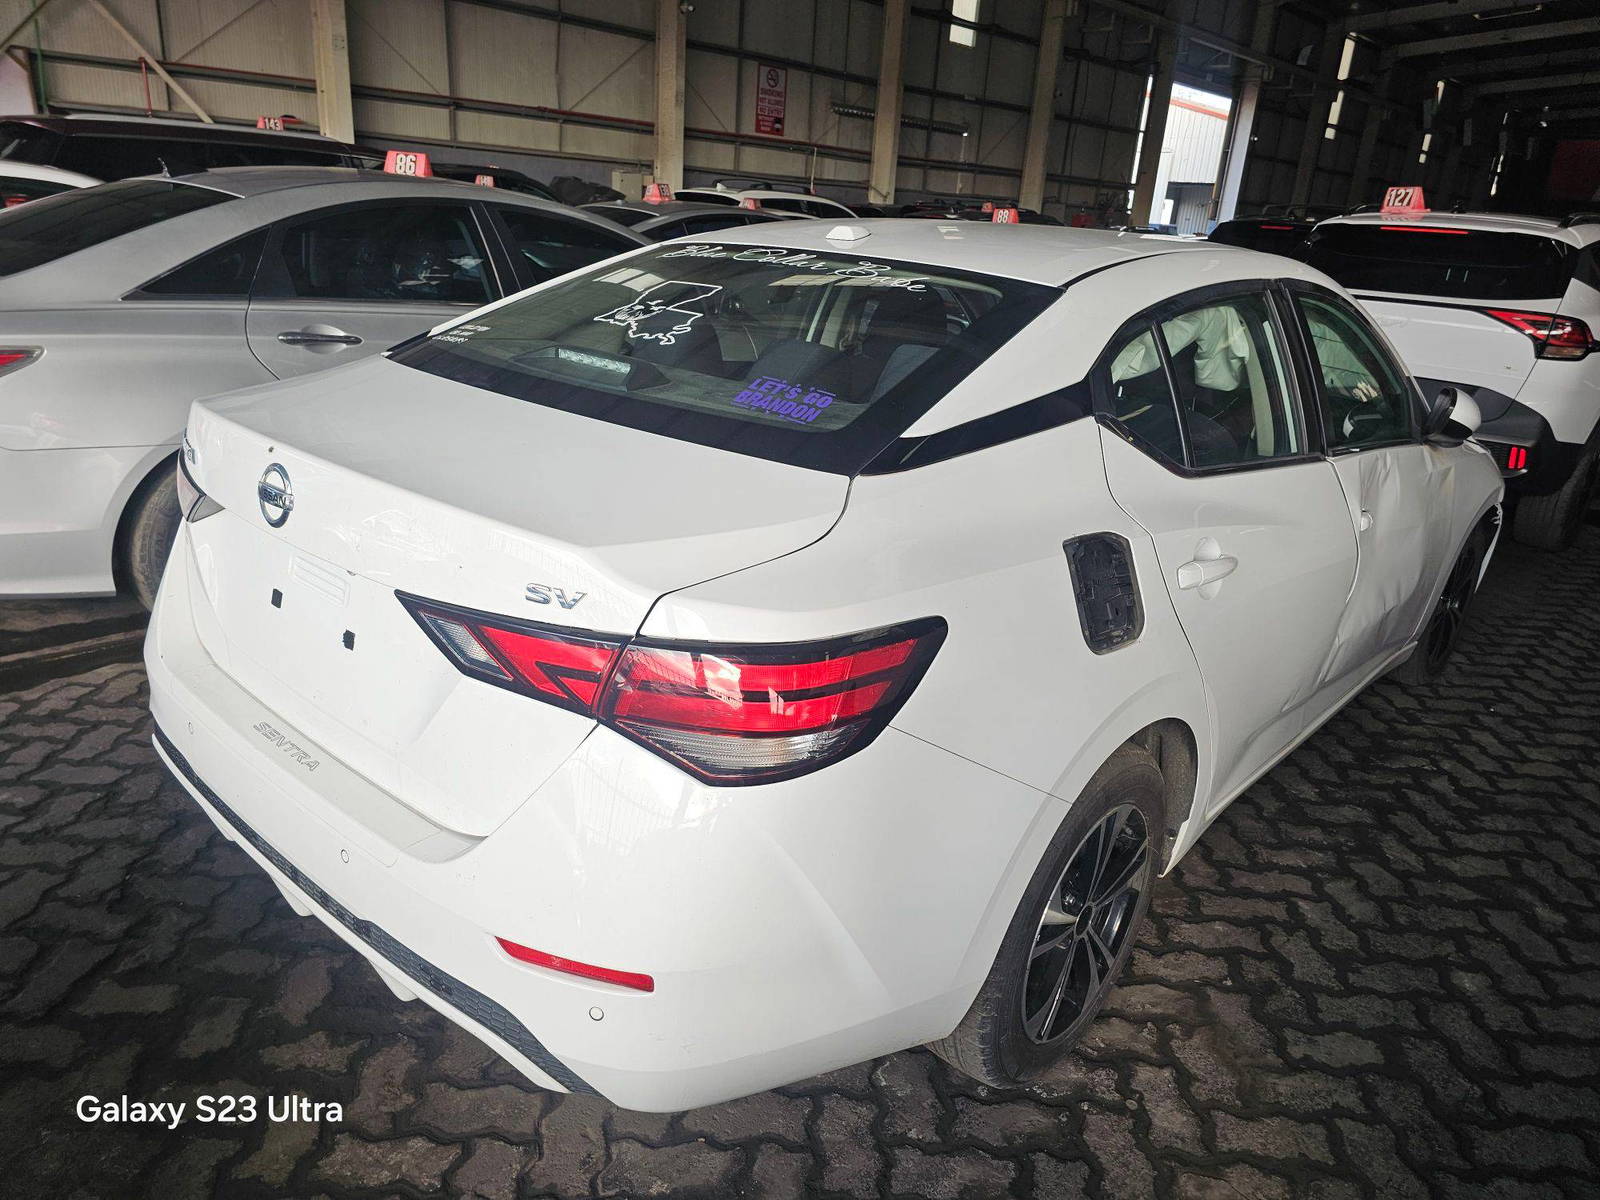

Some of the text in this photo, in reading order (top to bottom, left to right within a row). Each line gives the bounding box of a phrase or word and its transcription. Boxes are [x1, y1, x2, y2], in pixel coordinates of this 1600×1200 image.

[264, 117, 281, 131] 143
[395, 153, 417, 176] 86
[1387, 188, 1414, 207] 127
[997, 208, 1010, 224] 88
[733, 248, 829, 271] Collar
[748, 378, 834, 409] LET'S GO
[735, 391, 824, 422] BRANDON
[525, 582, 588, 610] SV
[253, 721, 320, 772] SENTRA
